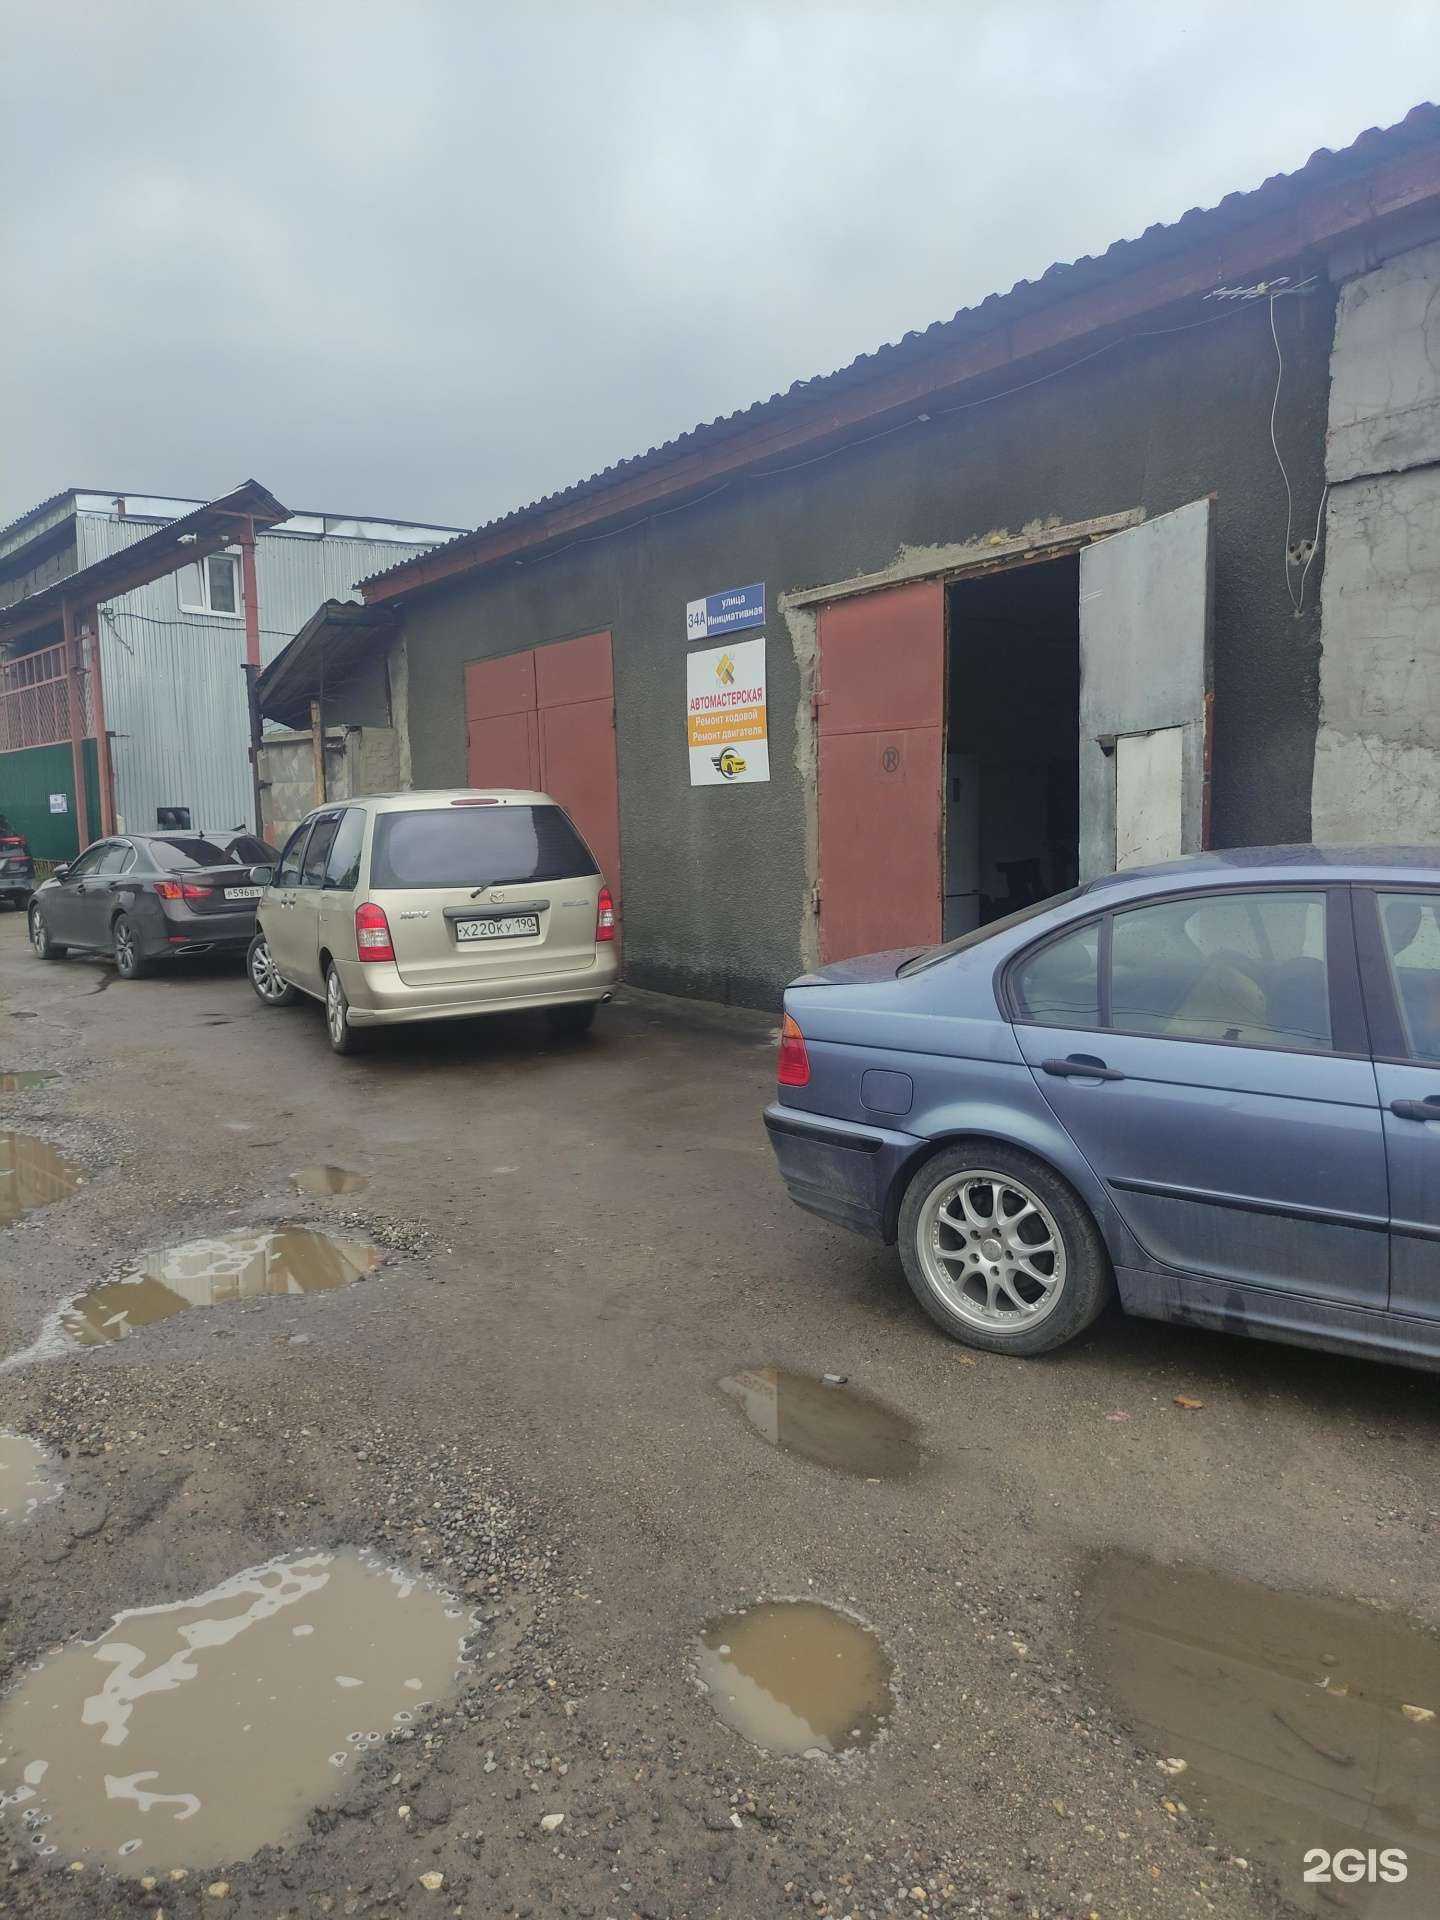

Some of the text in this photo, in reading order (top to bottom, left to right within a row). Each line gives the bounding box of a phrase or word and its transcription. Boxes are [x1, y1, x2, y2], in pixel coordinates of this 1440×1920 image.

[721, 594, 746, 610] улица
[688, 610, 706, 628] 34А
[707, 606, 763, 626] Инициативная
[690, 687, 763, 711] АВТОМАСТЕРСКАЯ
[695, 714, 724, 727] Ремонт
[692, 726, 763, 742] Ремонт двигателя
